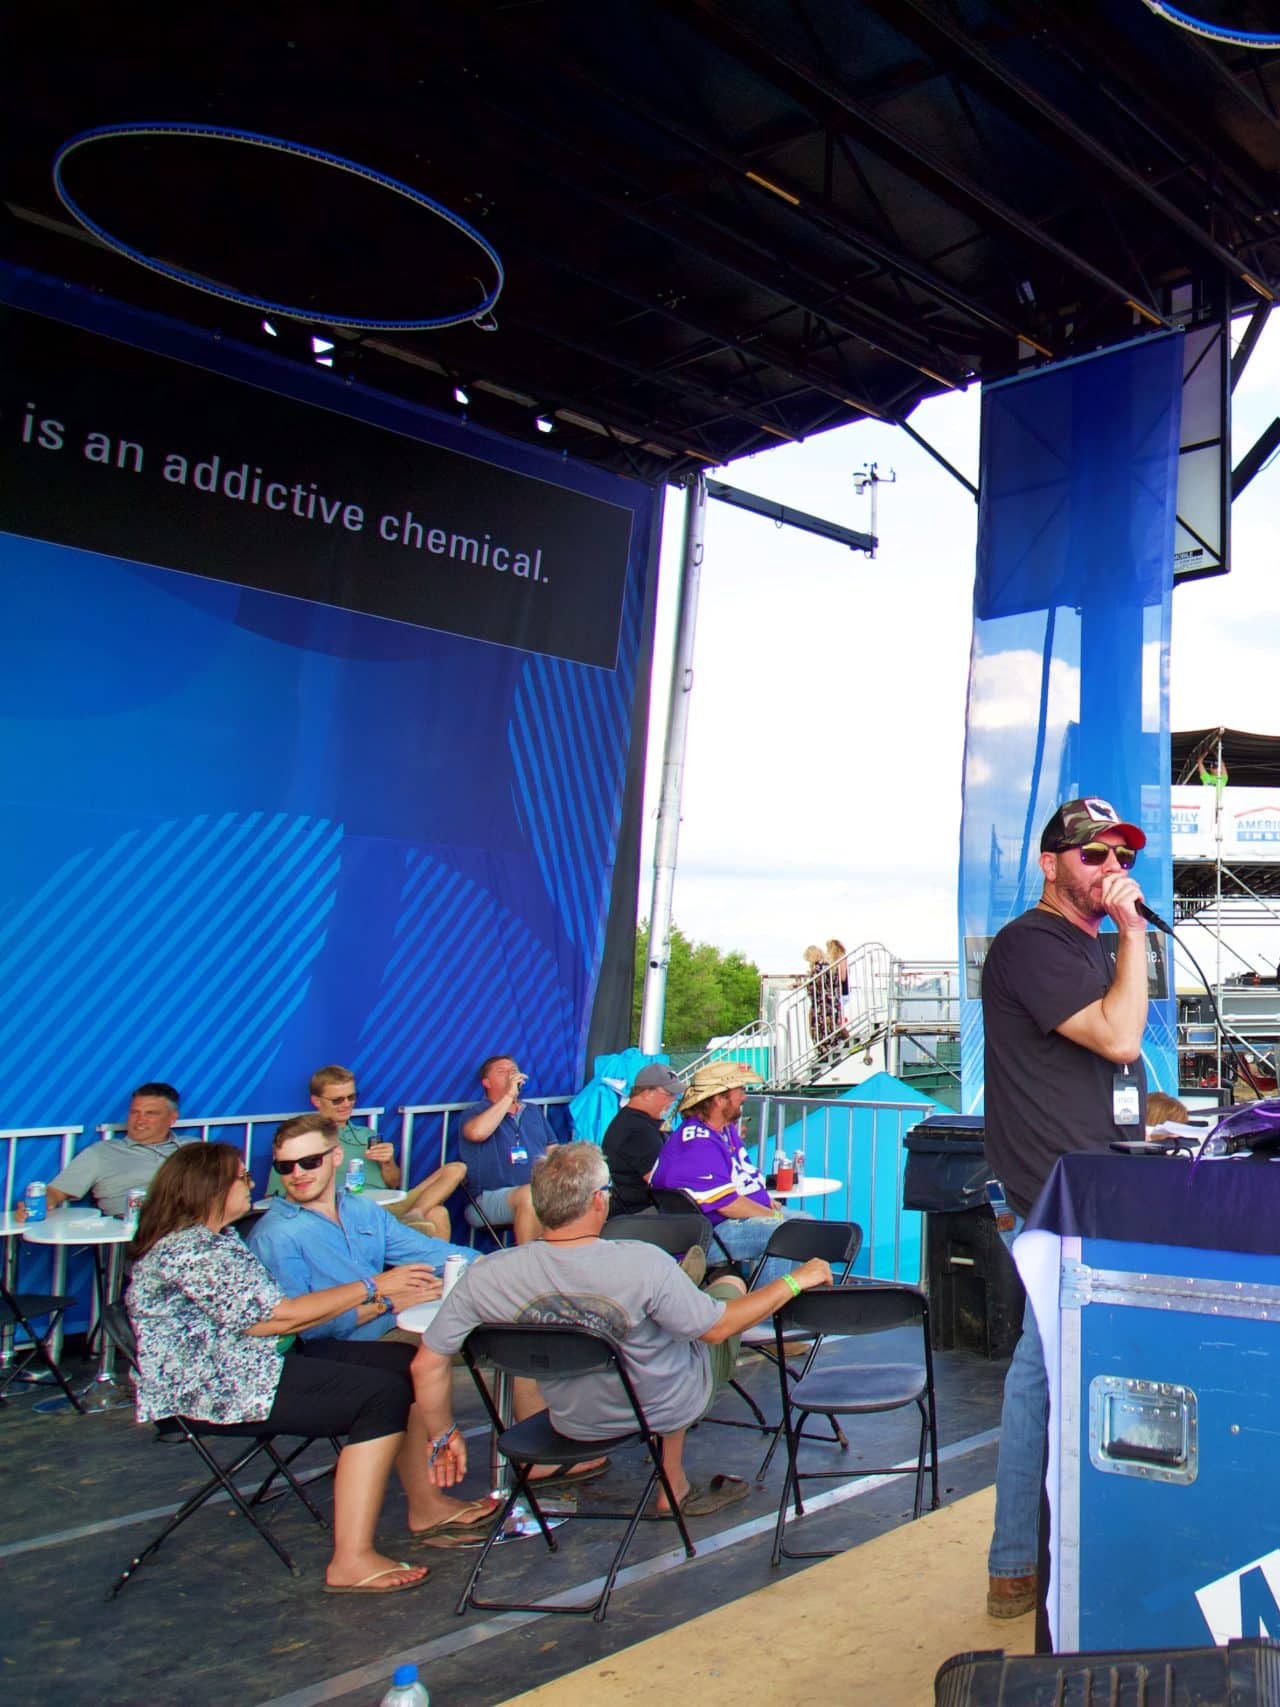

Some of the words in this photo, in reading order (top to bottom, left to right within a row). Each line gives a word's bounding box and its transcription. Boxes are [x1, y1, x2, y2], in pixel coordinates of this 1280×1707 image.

[21, 403, 65, 450] is
[84, 430, 144, 473] an
[162, 447, 365, 532] addictive
[379, 510, 550, 584] chemical.
